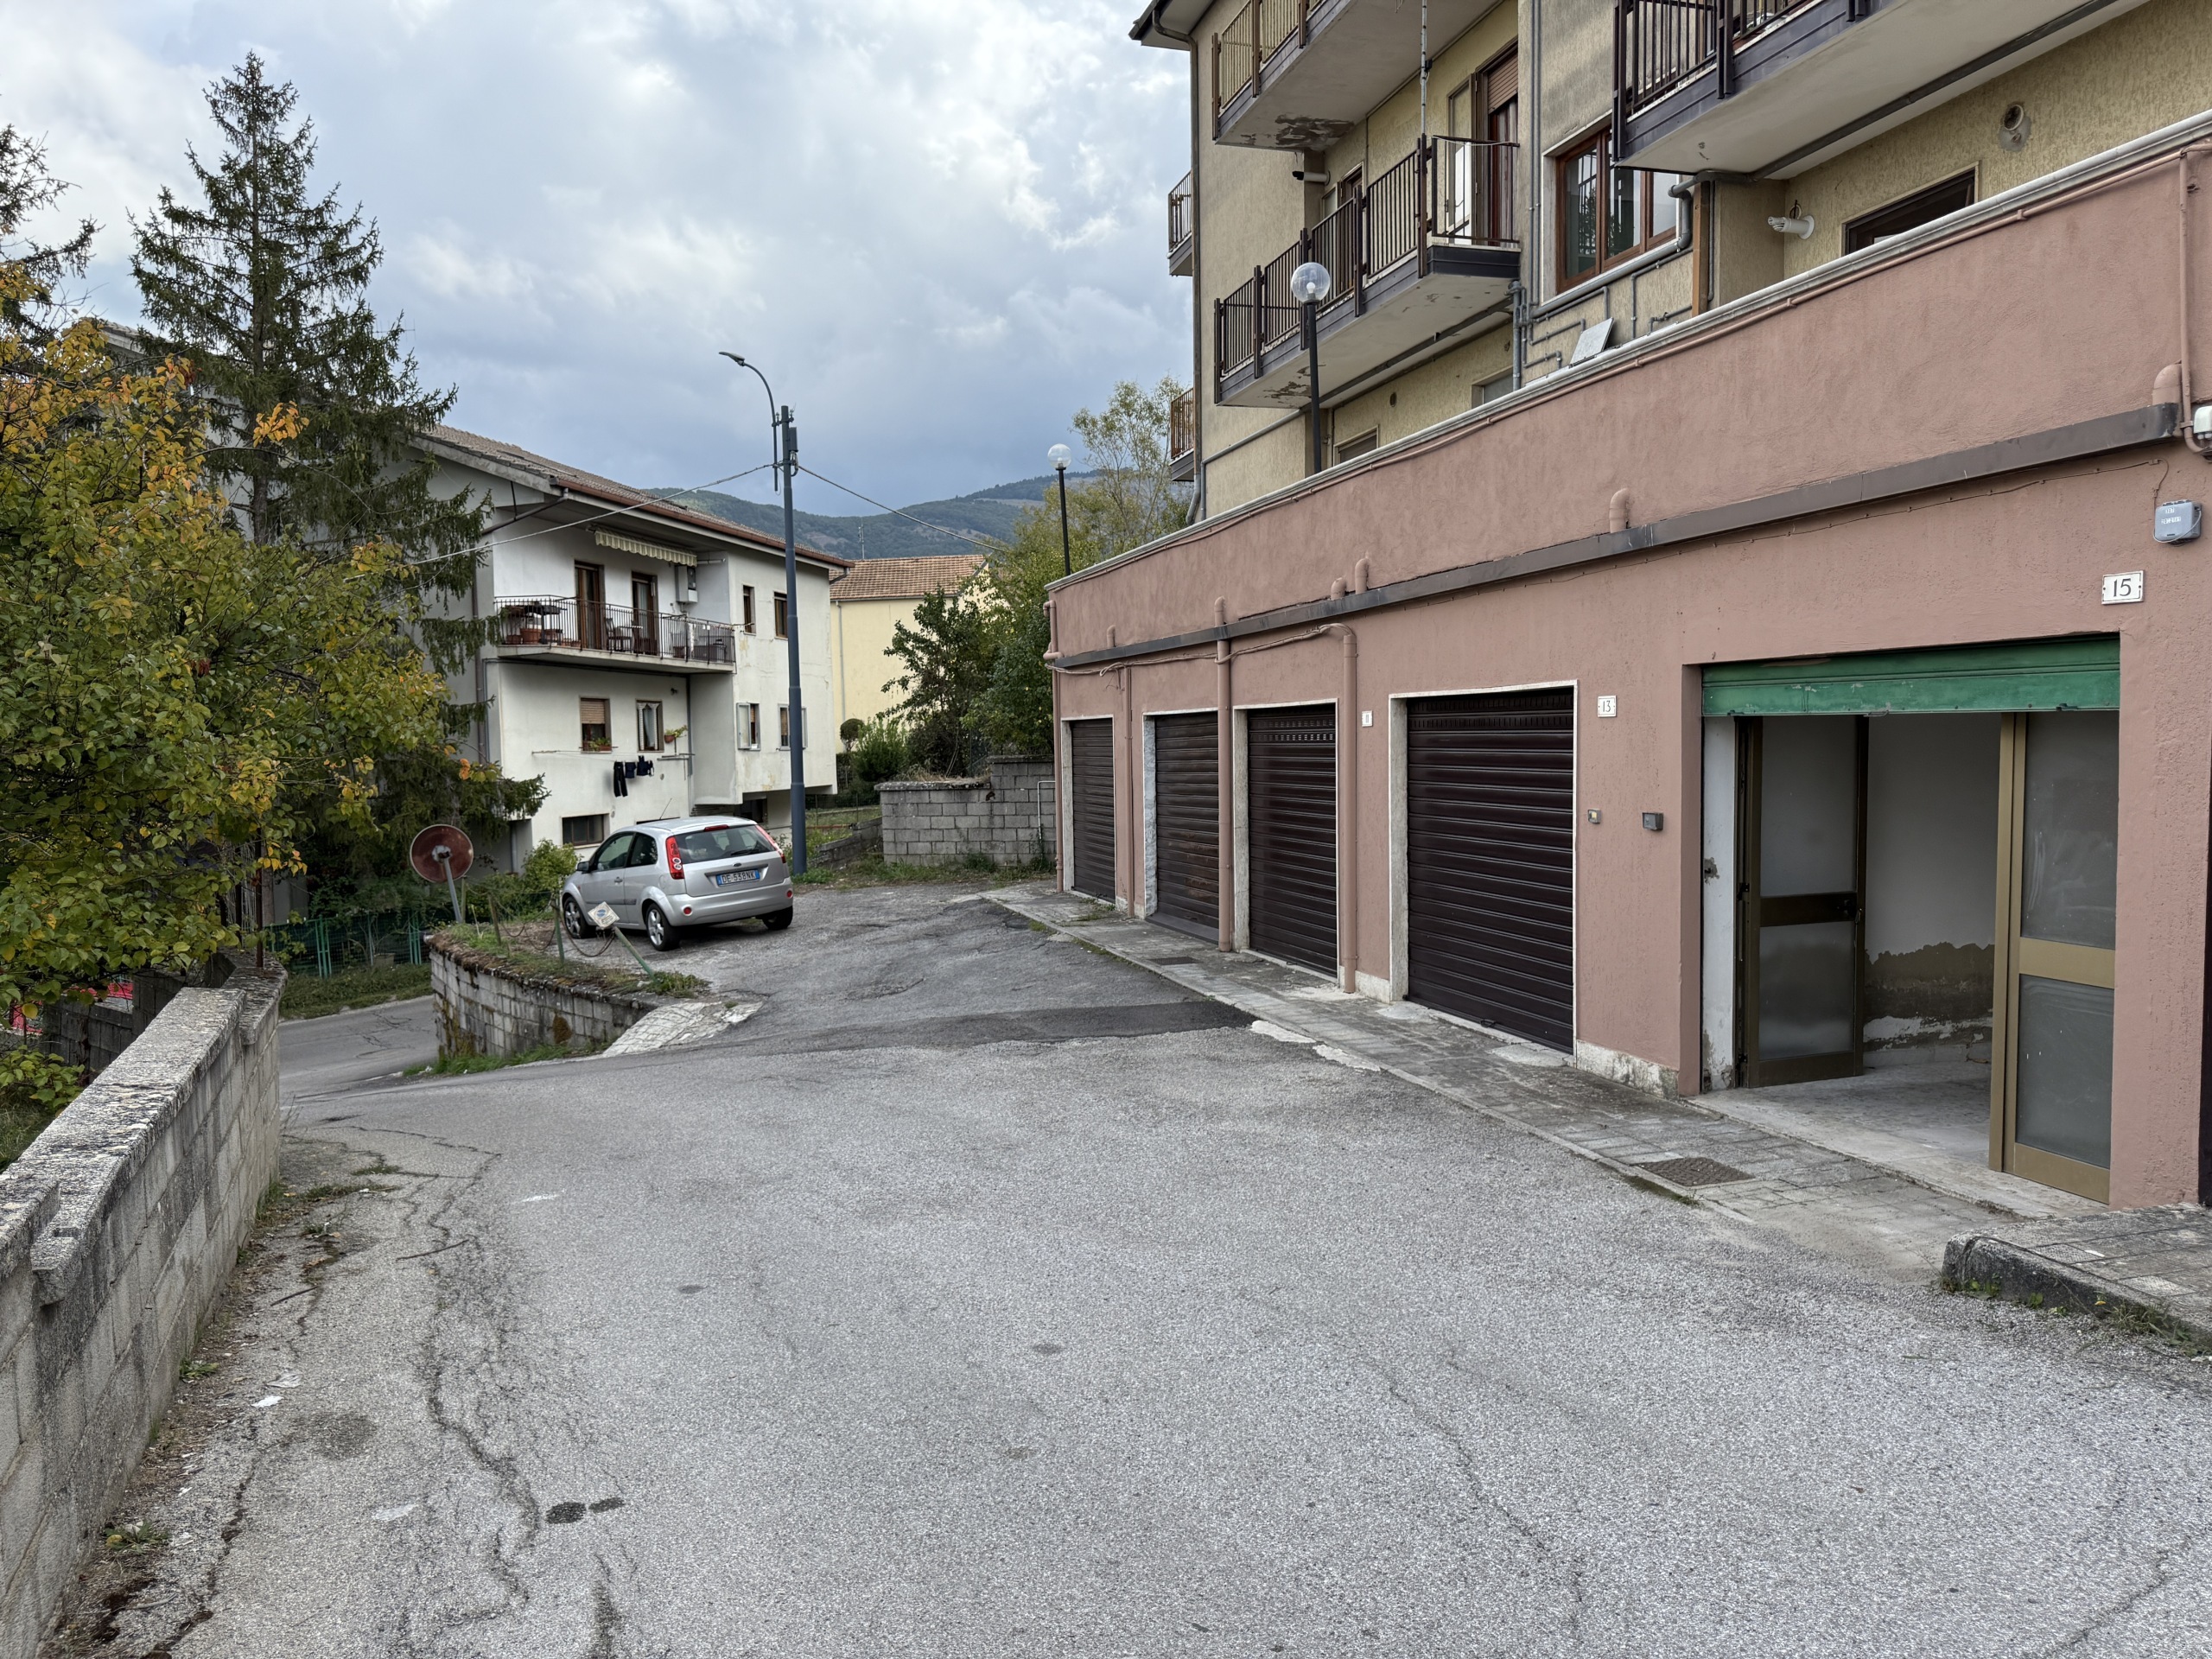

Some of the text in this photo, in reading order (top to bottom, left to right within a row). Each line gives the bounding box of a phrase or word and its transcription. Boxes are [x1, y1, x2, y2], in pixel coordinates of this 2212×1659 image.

[2113, 577, 2132, 597] 15
[1603, 700, 1611, 712] 13
[721, 874, 732, 883] DE
